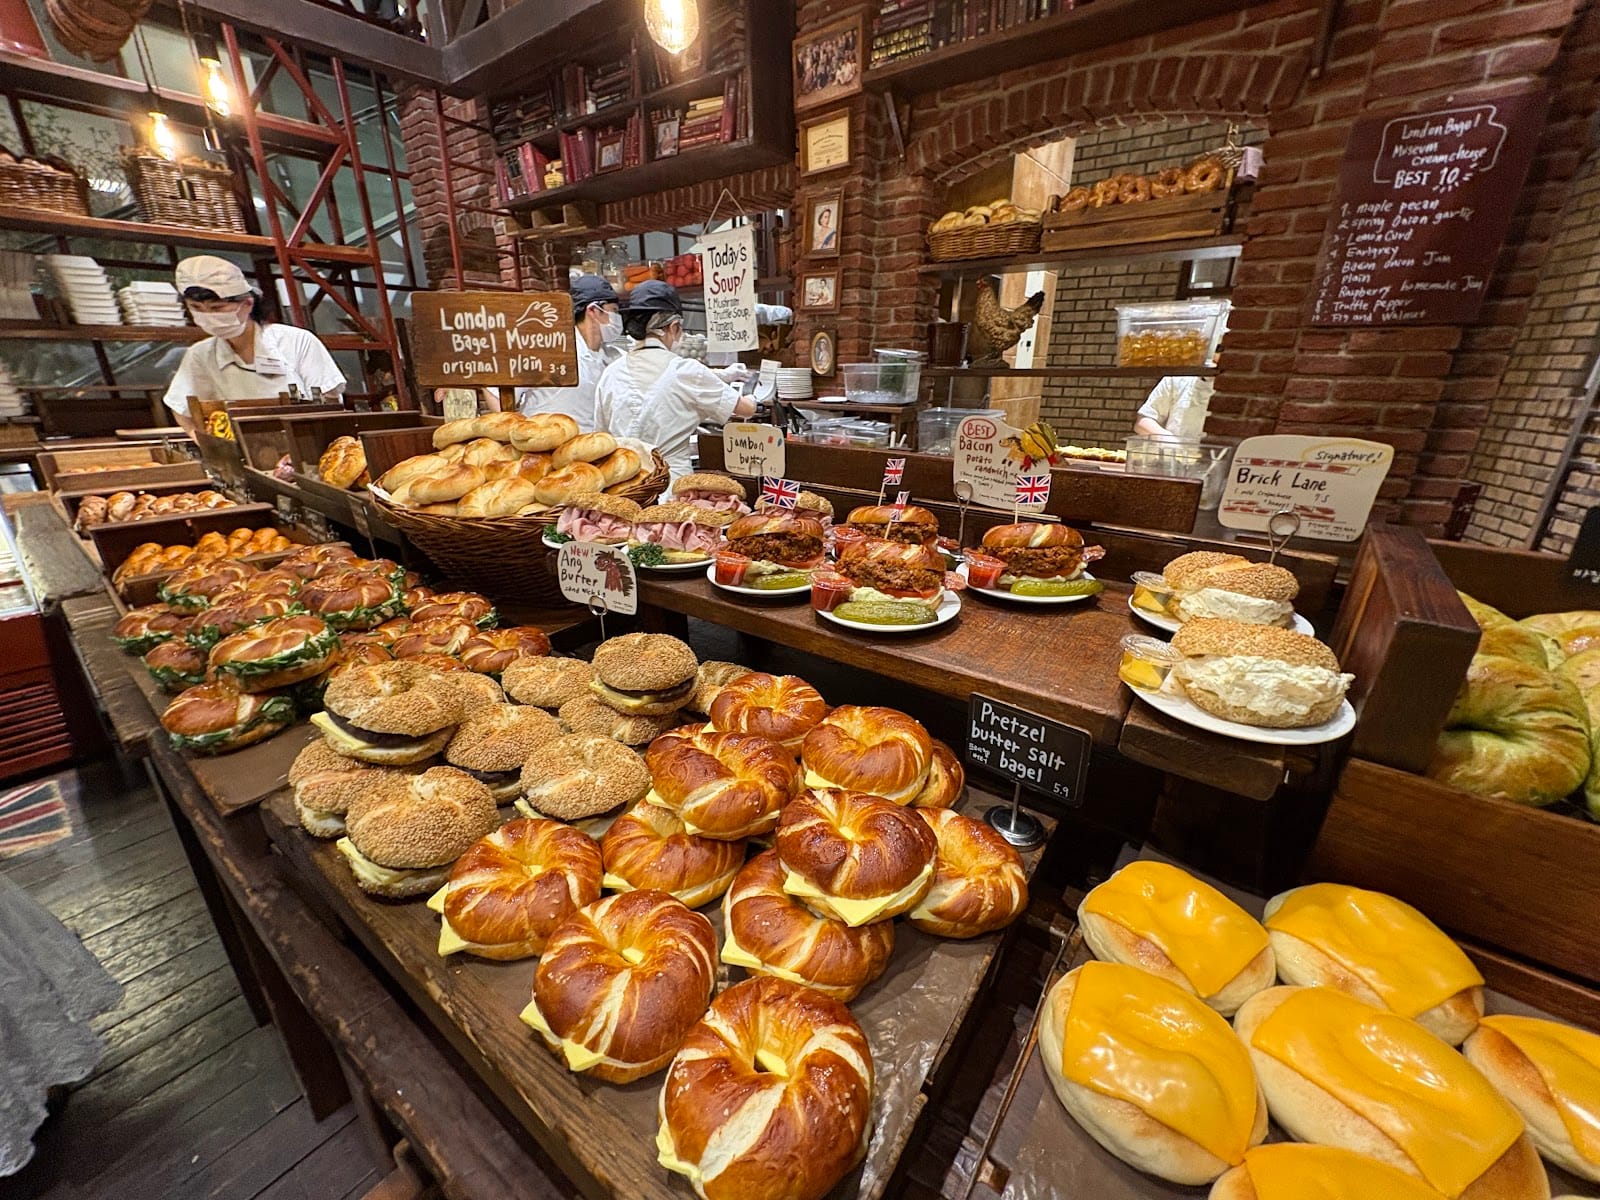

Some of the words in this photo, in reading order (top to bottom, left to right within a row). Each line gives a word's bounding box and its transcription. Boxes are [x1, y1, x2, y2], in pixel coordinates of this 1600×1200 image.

[1392, 142, 1439, 158] Museum
[1394, 169, 1431, 189] BEST
[1357, 200, 1393, 216] maple
[1400, 200, 1440, 214] pecan
[1351, 217, 1385, 233] spring
[707, 243, 747, 271] Today's
[1342, 261, 1376, 274] Bacon
[1423, 251, 1451, 266] Jam
[709, 268, 746, 296] Soup!
[440, 305, 506, 332] London
[1352, 313, 1373, 322] and
[451, 333, 496, 356] Bagel
[506, 327, 567, 352] Museum
[443, 356, 499, 379] original
[509, 354, 543, 378] plain
[549, 363, 567, 376] 3.8
[967, 422, 990, 438] BEST
[727, 436, 764, 453] jambon
[959, 435, 993, 454] Bacon
[974, 464, 1008, 479] sandwich
[1236, 467, 1283, 487] Brick
[1291, 472, 1328, 492] Lane
[560, 549, 583, 574] Ang
[980, 701, 1046, 744] Pretzel
[971, 719, 1021, 754] butter
[1027, 746, 1066, 771] salt
[999, 750, 1042, 783] bagel
[1053, 782, 1069, 798] 5.9
